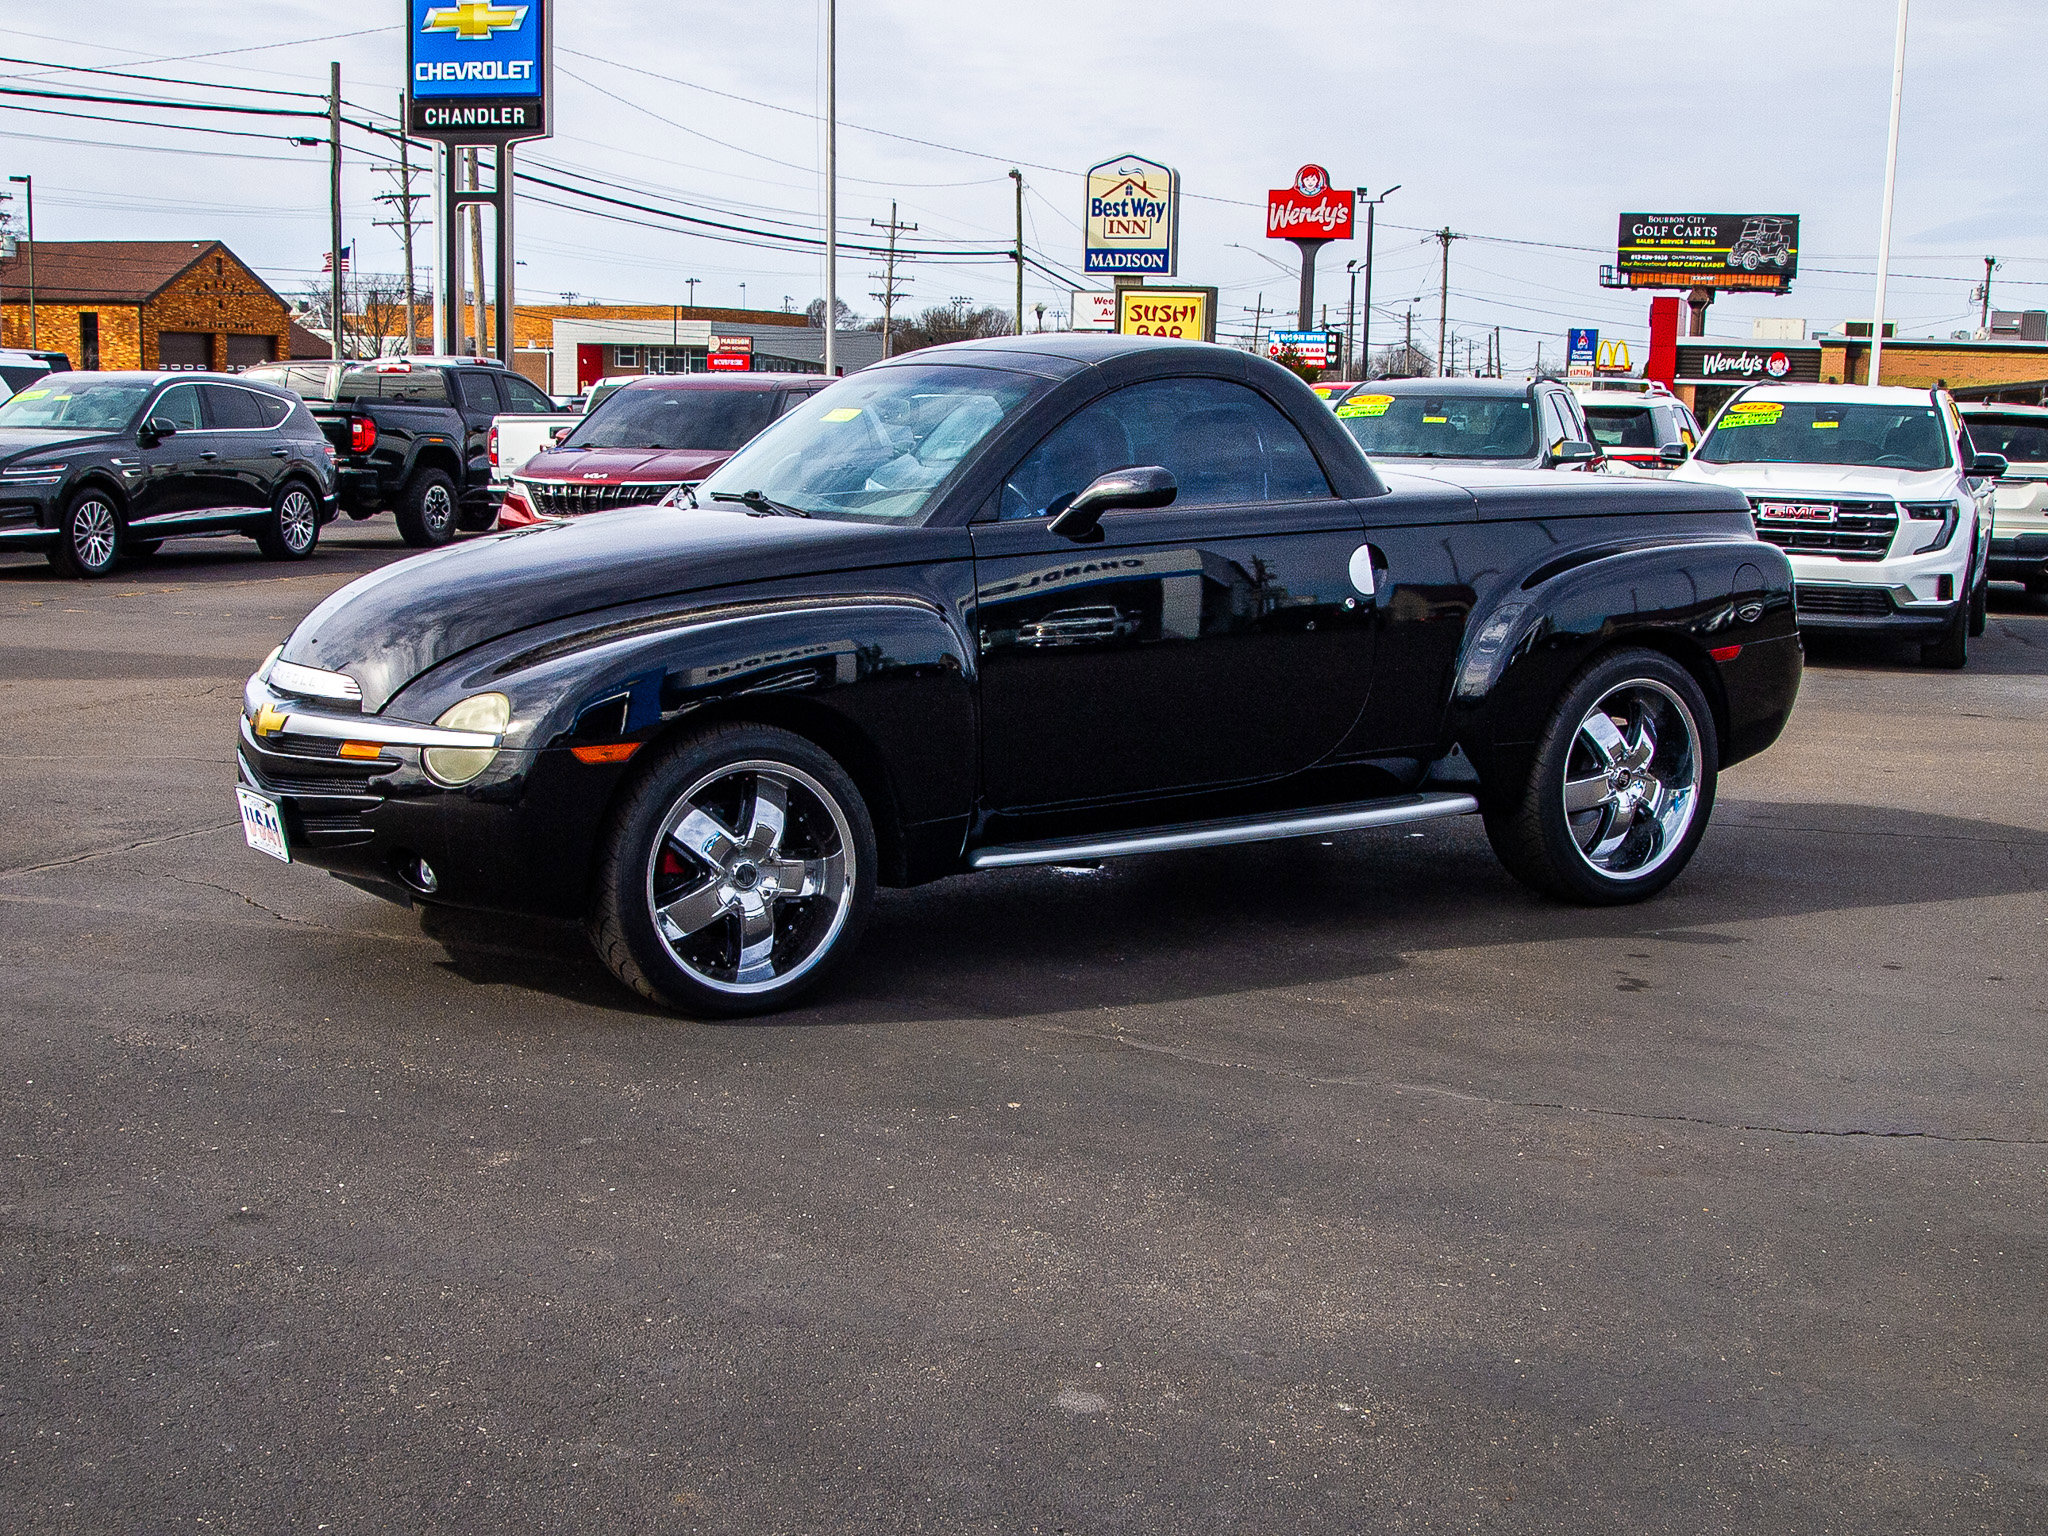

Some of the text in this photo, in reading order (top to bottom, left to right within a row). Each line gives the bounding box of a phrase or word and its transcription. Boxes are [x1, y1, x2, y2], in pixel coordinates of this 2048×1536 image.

[415, 60, 533, 81] CHEVROLET
[424, 107, 525, 125] CHANDLER
[1091, 197, 1166, 223] Best Way
[1269, 196, 1349, 231] Wendy's
[1107, 219, 1147, 234] INN
[1632, 223, 1718, 237] GOLF CARTS
[1089, 253, 1164, 268] MADISON
[1093, 296, 1115, 305] Wee
[1101, 308, 1114, 316] Av
[1129, 304, 1196, 323] SUSHI
[1136, 325, 1183, 338] BAR
[1703, 350, 1763, 376] Wendy's
[1765, 505, 1831, 520] GMC
